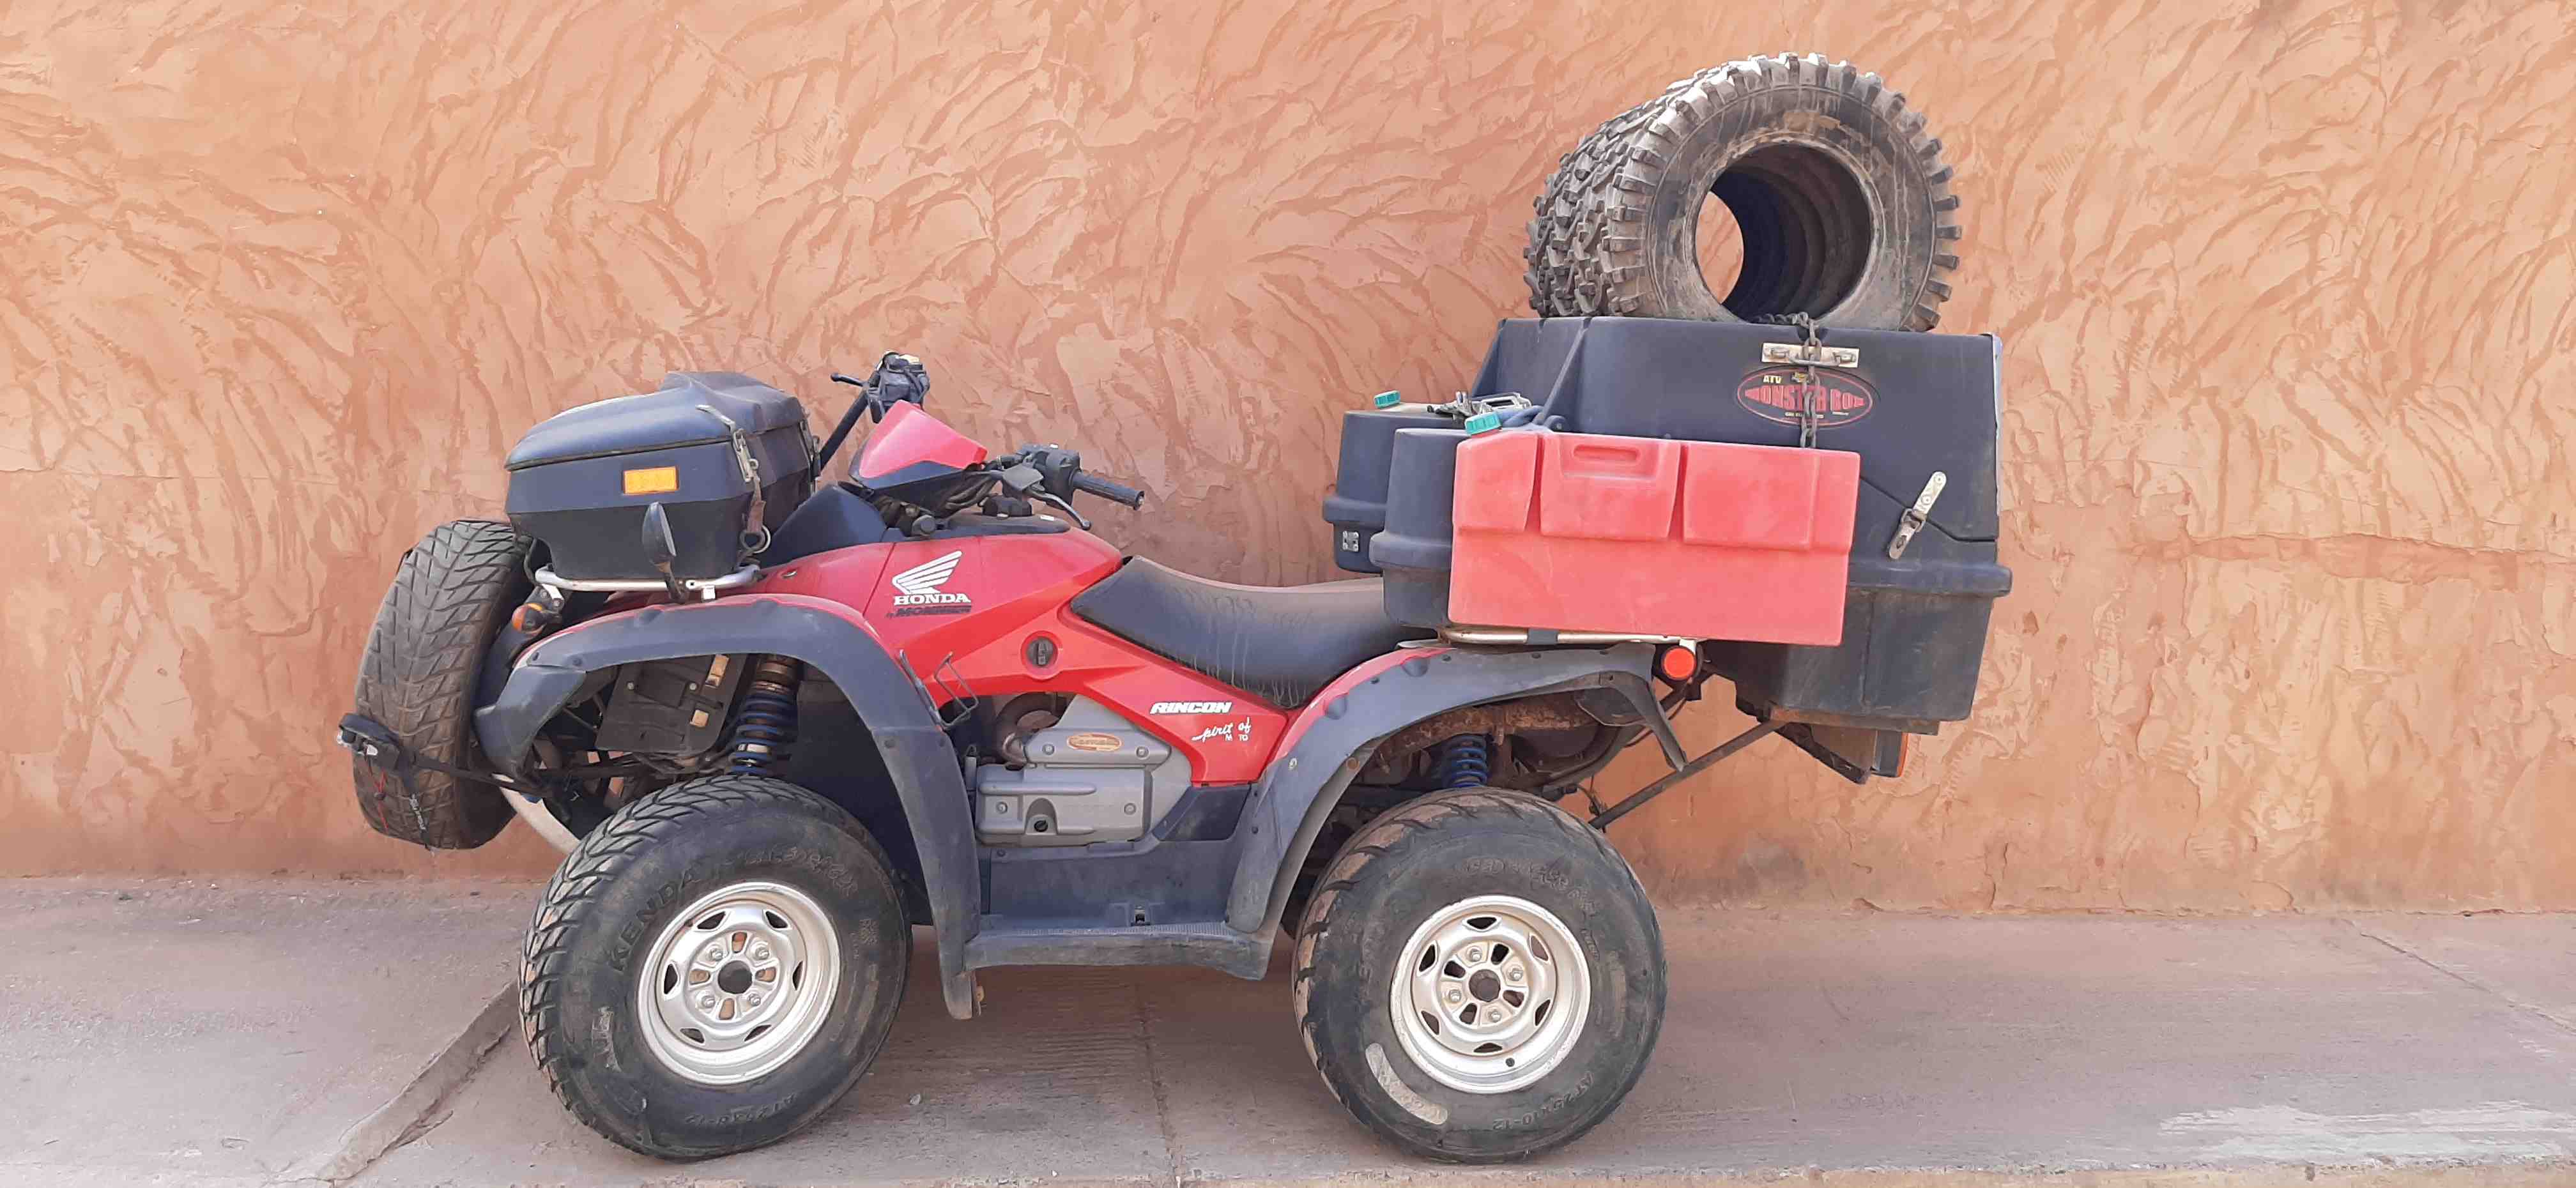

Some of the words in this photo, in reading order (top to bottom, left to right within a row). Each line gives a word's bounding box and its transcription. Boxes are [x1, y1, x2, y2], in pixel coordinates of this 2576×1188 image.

[1763, 375, 1782, 384] ATV
[1745, 385, 1827, 412] MONSTR
[894, 593, 971, 605] HONDA
[1150, 702, 1232, 714] RINCON
[1238, 717, 1251, 734] of
[610, 867, 699, 975] KENDA
